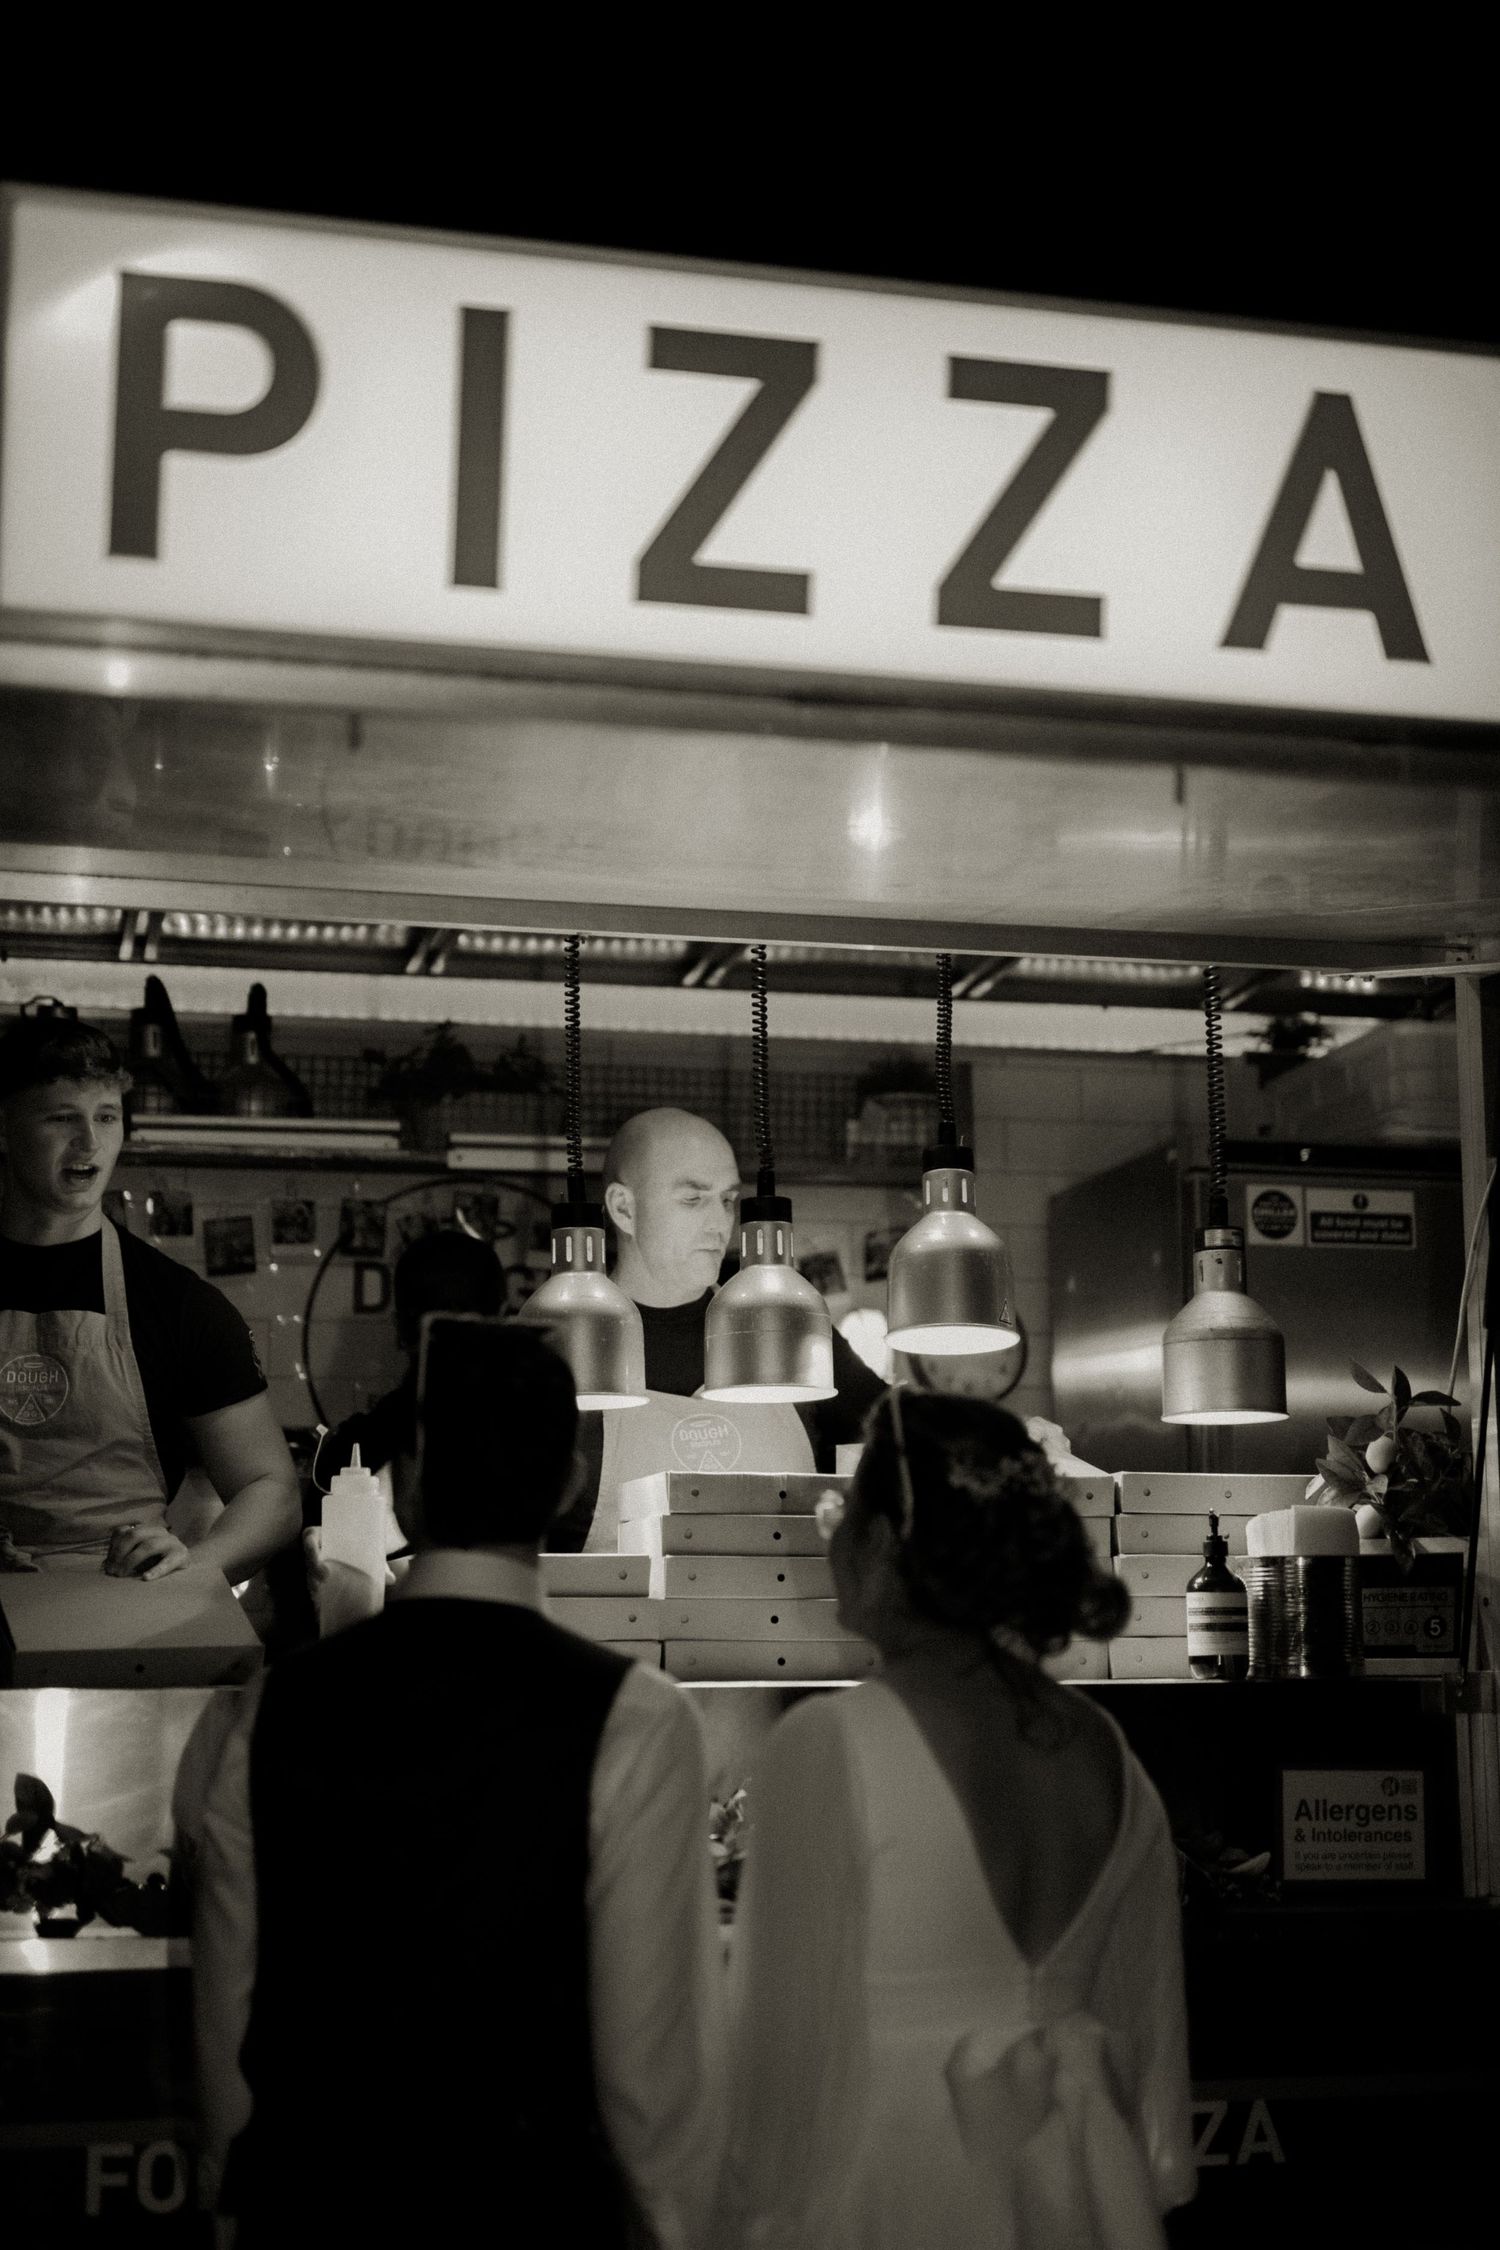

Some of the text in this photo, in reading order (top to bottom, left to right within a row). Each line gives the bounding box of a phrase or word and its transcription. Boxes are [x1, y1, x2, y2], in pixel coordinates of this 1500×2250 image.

[107, 270, 1432, 664] PIZZA
[6, 1370, 59, 1384] DOUGH
[679, 1424, 729, 1441] DOUGH
[1363, 1591, 1449, 1602] HYGIENE RATING
[1429, 1618, 1441, 1637] 5
[1294, 1798, 1418, 1827] Allergens
[1294, 1827, 1413, 1843] & Intolerances
[85, 2140, 214, 2215] FO
